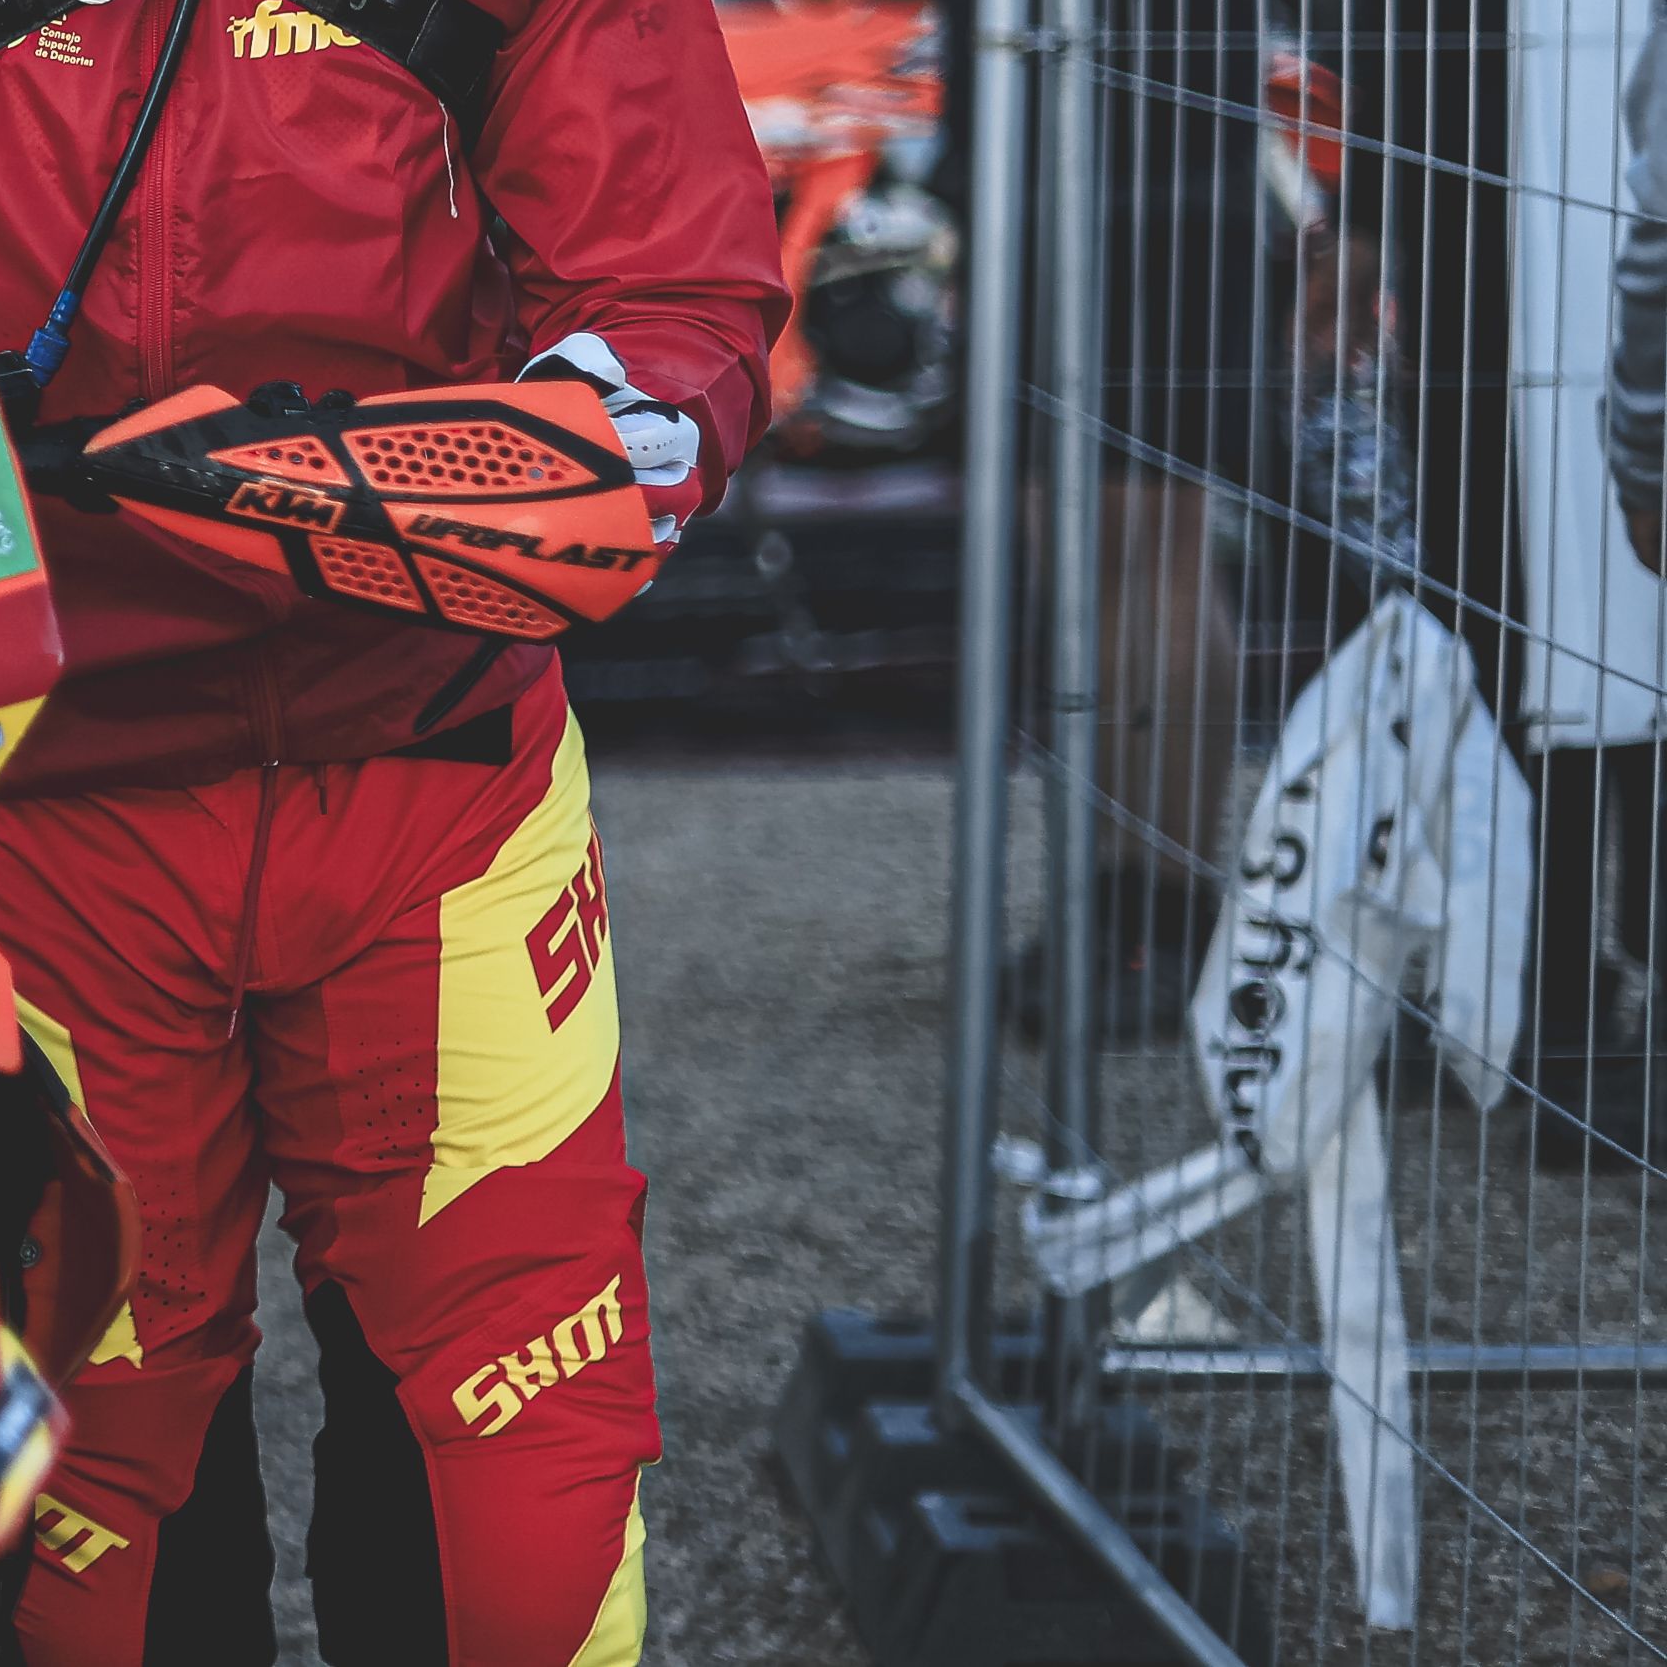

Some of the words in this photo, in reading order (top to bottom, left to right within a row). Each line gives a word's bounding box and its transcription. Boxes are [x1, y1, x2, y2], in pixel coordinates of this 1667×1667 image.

[38, 36, 81, 54] Superior
[40, 26, 81, 43] Consejo
[34, 48, 48, 58] de
[50, 50, 94, 67] Deportes
[234, 484, 337, 529] KTM
[405, 512, 653, 573] UFOPLAST
[452, 1272, 624, 1438] SHOT
